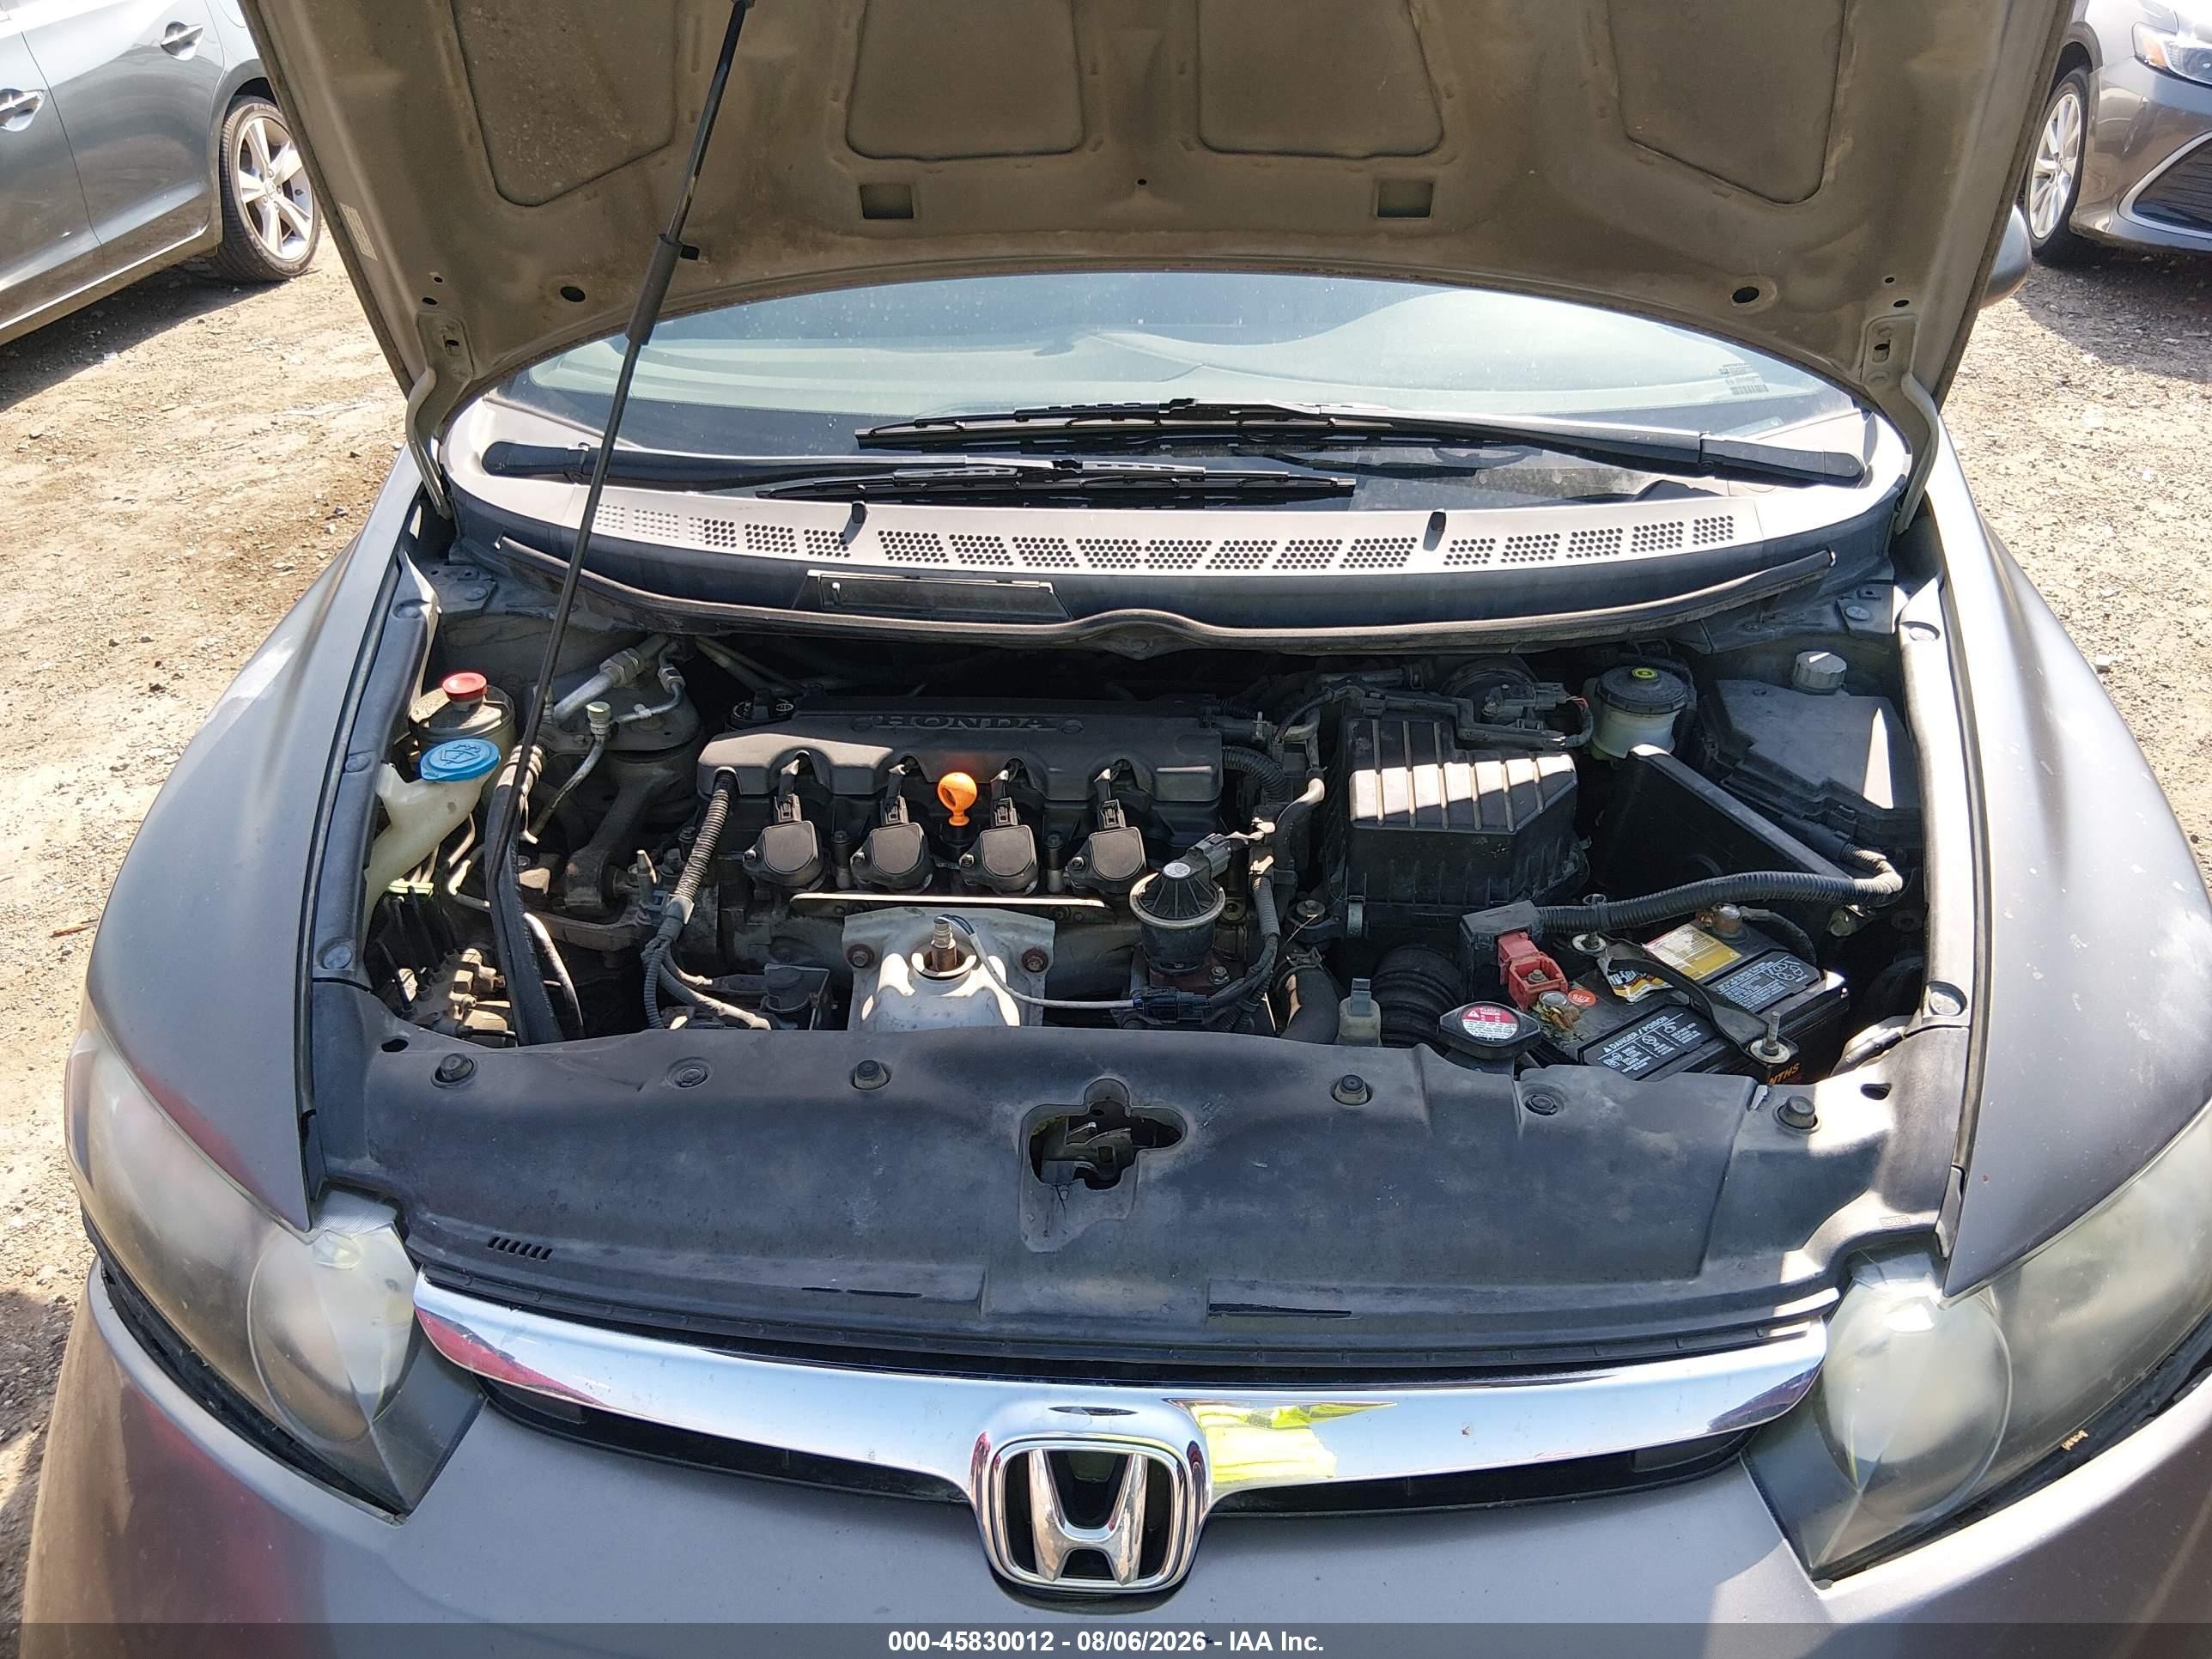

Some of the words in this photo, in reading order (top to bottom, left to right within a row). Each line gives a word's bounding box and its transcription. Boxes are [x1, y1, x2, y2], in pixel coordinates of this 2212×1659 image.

[871, 714, 1057, 730] HONDA
[1608, 1031, 1639, 1049] DANGER
[1642, 1016, 1669, 1032] POISON
[1768, 1061, 1801, 1085] NTHS
